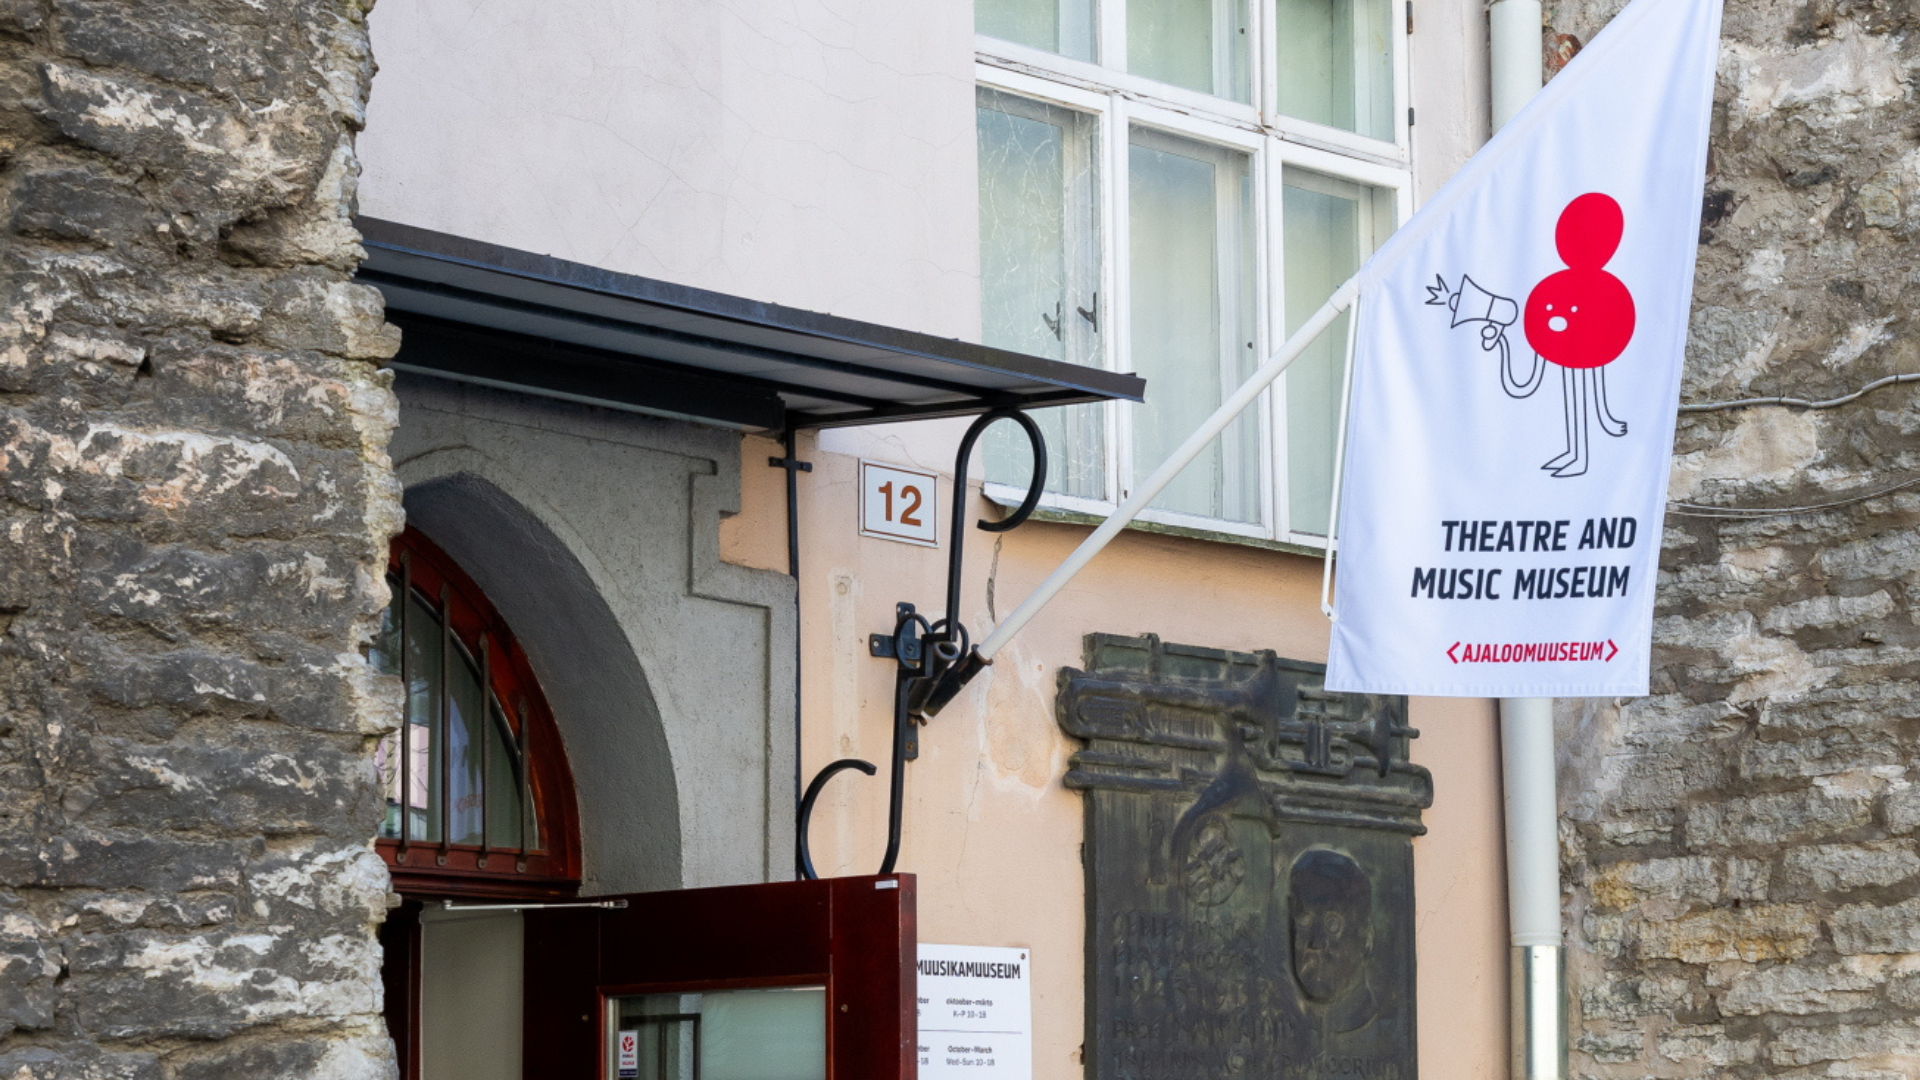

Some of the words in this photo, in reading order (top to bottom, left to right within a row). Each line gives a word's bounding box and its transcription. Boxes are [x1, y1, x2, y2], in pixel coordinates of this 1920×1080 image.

[878, 481, 922, 527] 12
[1442, 520, 1570, 552] THEATRE
[1577, 517, 1637, 550] AND
[1411, 566, 1503, 600] MUSIC
[1513, 565, 1631, 600] MUSEUM
